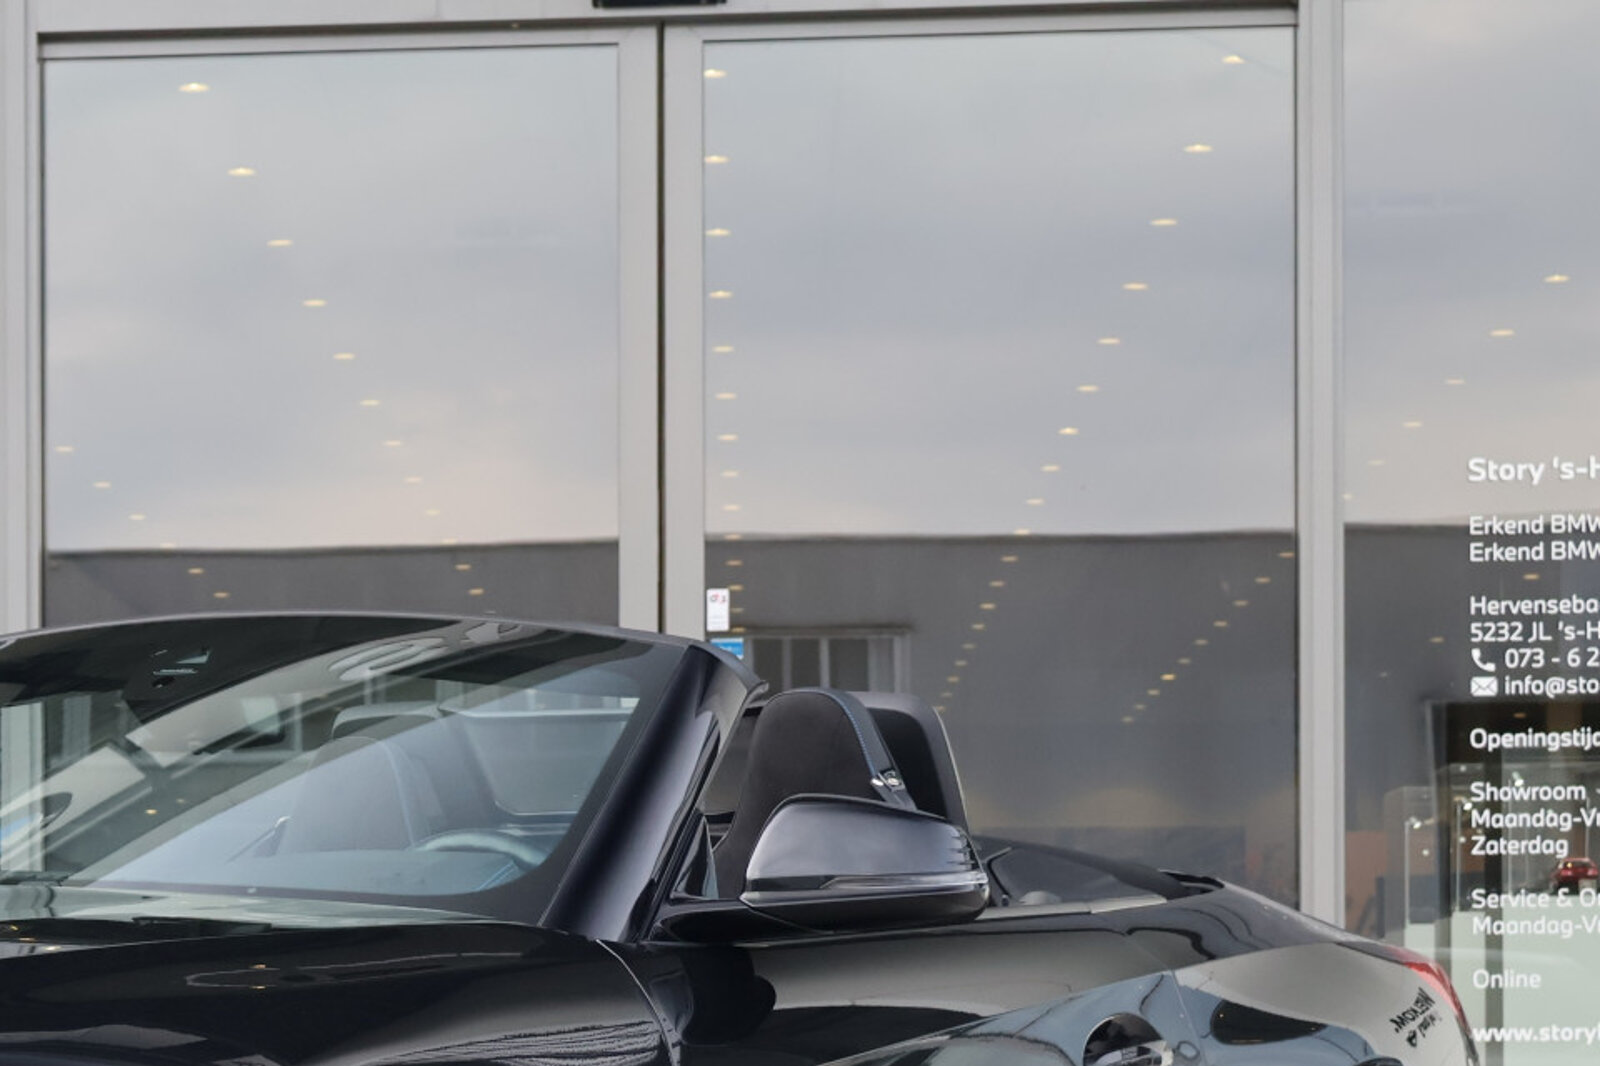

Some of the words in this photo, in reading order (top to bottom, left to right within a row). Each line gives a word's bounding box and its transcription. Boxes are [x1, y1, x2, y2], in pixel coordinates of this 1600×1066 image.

[1468, 457, 1545, 485] Story
[1469, 515, 1544, 535] Erkend
[1469, 541, 1544, 562] Erkend
[1470, 594, 1599, 615] Hervenseba
[1470, 621, 1524, 642] 5232
[1528, 620, 1553, 643] JL
[1505, 647, 1545, 668] 073
[1567, 647, 1580, 668] 6
[1504, 674, 1600, 699] info@sto
[1470, 781, 1587, 802] Showroom
[1471, 807, 1600, 832] Maandag-V
[1471, 835, 1569, 859] Zaterdag
[1471, 888, 1550, 909] Service
[1556, 887, 1574, 908] &
[1472, 915, 1600, 940] Maandag-V
[1472, 968, 1542, 989] Online
[1472, 1023, 1600, 1046] www.story
